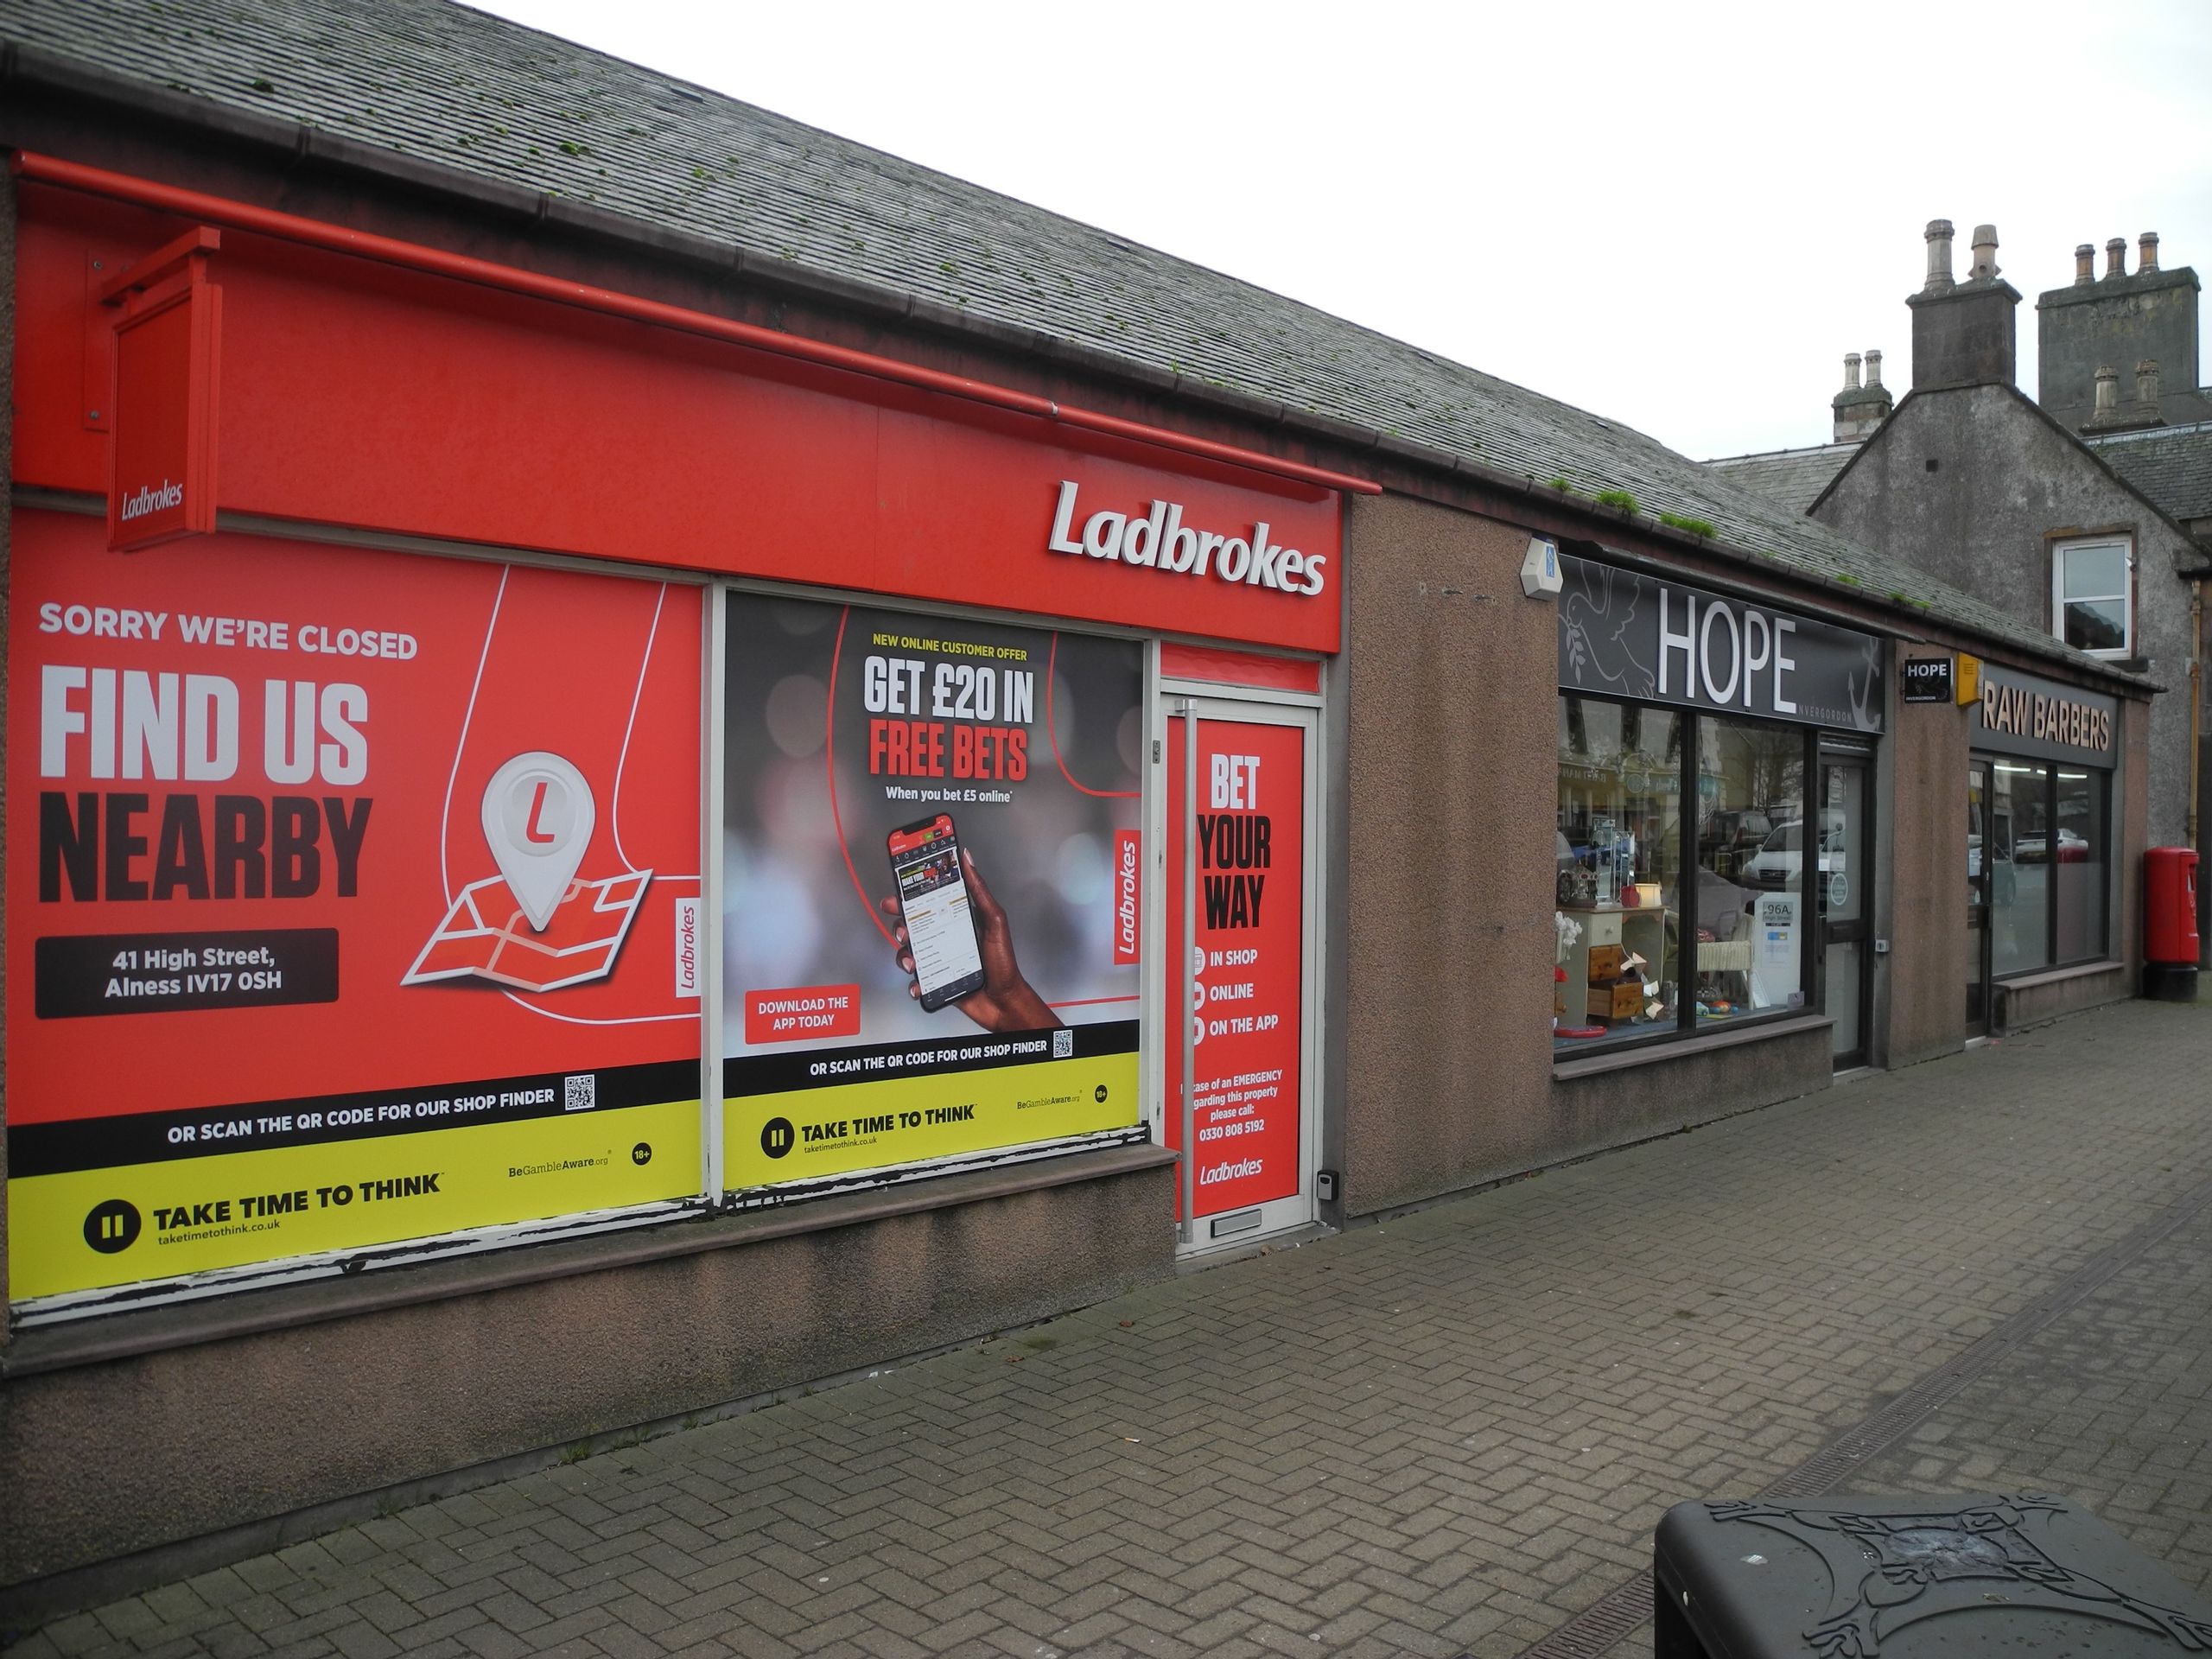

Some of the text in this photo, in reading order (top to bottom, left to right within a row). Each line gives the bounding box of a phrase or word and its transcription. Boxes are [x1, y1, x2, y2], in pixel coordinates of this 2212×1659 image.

[122, 479, 182, 521] Ladbrokes
[1048, 480, 1327, 596] Ladbrokes
[39, 602, 417, 659] SORRY WE'RE CLOSED
[873, 633, 1027, 661] NEW ONLINE CUSTOMER OFFER
[1658, 588, 1796, 714] HOPE
[1908, 664, 1947, 677] HOPE
[864, 656, 1033, 724] GET £20 IN
[41, 664, 368, 785] FIND US
[1799, 704, 1852, 722] NVERGORDON
[1983, 680, 2109, 752] RAW BARBERS
[870, 719, 1027, 781] FREE BETS
[886, 786, 918, 799] When
[921, 791, 941, 802] you
[944, 788, 961, 801] bet
[963, 790, 976, 802] £5
[1211, 753, 1261, 810] BET
[39, 791, 373, 903] NEARBY
[1197, 814, 1271, 869] YOUR
[1119, 840, 1135, 955] Ladbrokes
[1204, 874, 1265, 930] WAY
[1767, 904, 1789, 915] 96A
[112, 947, 275, 971] 41 High Street,
[681, 906, 695, 989] Ladbrokes
[1211, 949, 1257, 967] IN SHOP
[105, 977, 181, 998] Alness
[187, 973, 232, 993] IV17
[1210, 982, 1254, 1001] ONLINE
[758, 996, 849, 1015] DOWNLOAD THE
[773, 1014, 835, 1030] APP TODAY
[1210, 1014, 1279, 1036] ON THE APP
[810, 1039, 1047, 1076] OR SCAN THE QR CODE FOR OUR SHOP FINDER
[1211, 1078, 1220, 1090] of
[1222, 1079, 1232, 1089] an
[1233, 1070, 1283, 1087] EMERGENCY
[1193, 1086, 1278, 1109] garding this property
[168, 1088, 555, 1144] OR SCAN THE QR CODE FOR OUR SHOP FINDER
[802, 1122, 848, 1142] TAKE
[852, 1115, 894, 1136] TIME
[898, 1110, 922, 1128] TO
[1211, 1103, 1255, 1122] please call:
[1199, 1119, 1265, 1141] 0330 808 5192
[804, 1135, 878, 1154] taketimetothink.co.uk
[509, 1149, 650, 1177] BeGambleAware.org 18+
[1199, 1158, 1263, 1185] Ladbrokes
[154, 1200, 231, 1230] TAKE
[239, 1190, 308, 1218] TIME
[316, 1185, 353, 1208] TO
[158, 1219, 280, 1245] taketimetothink.co.uk
